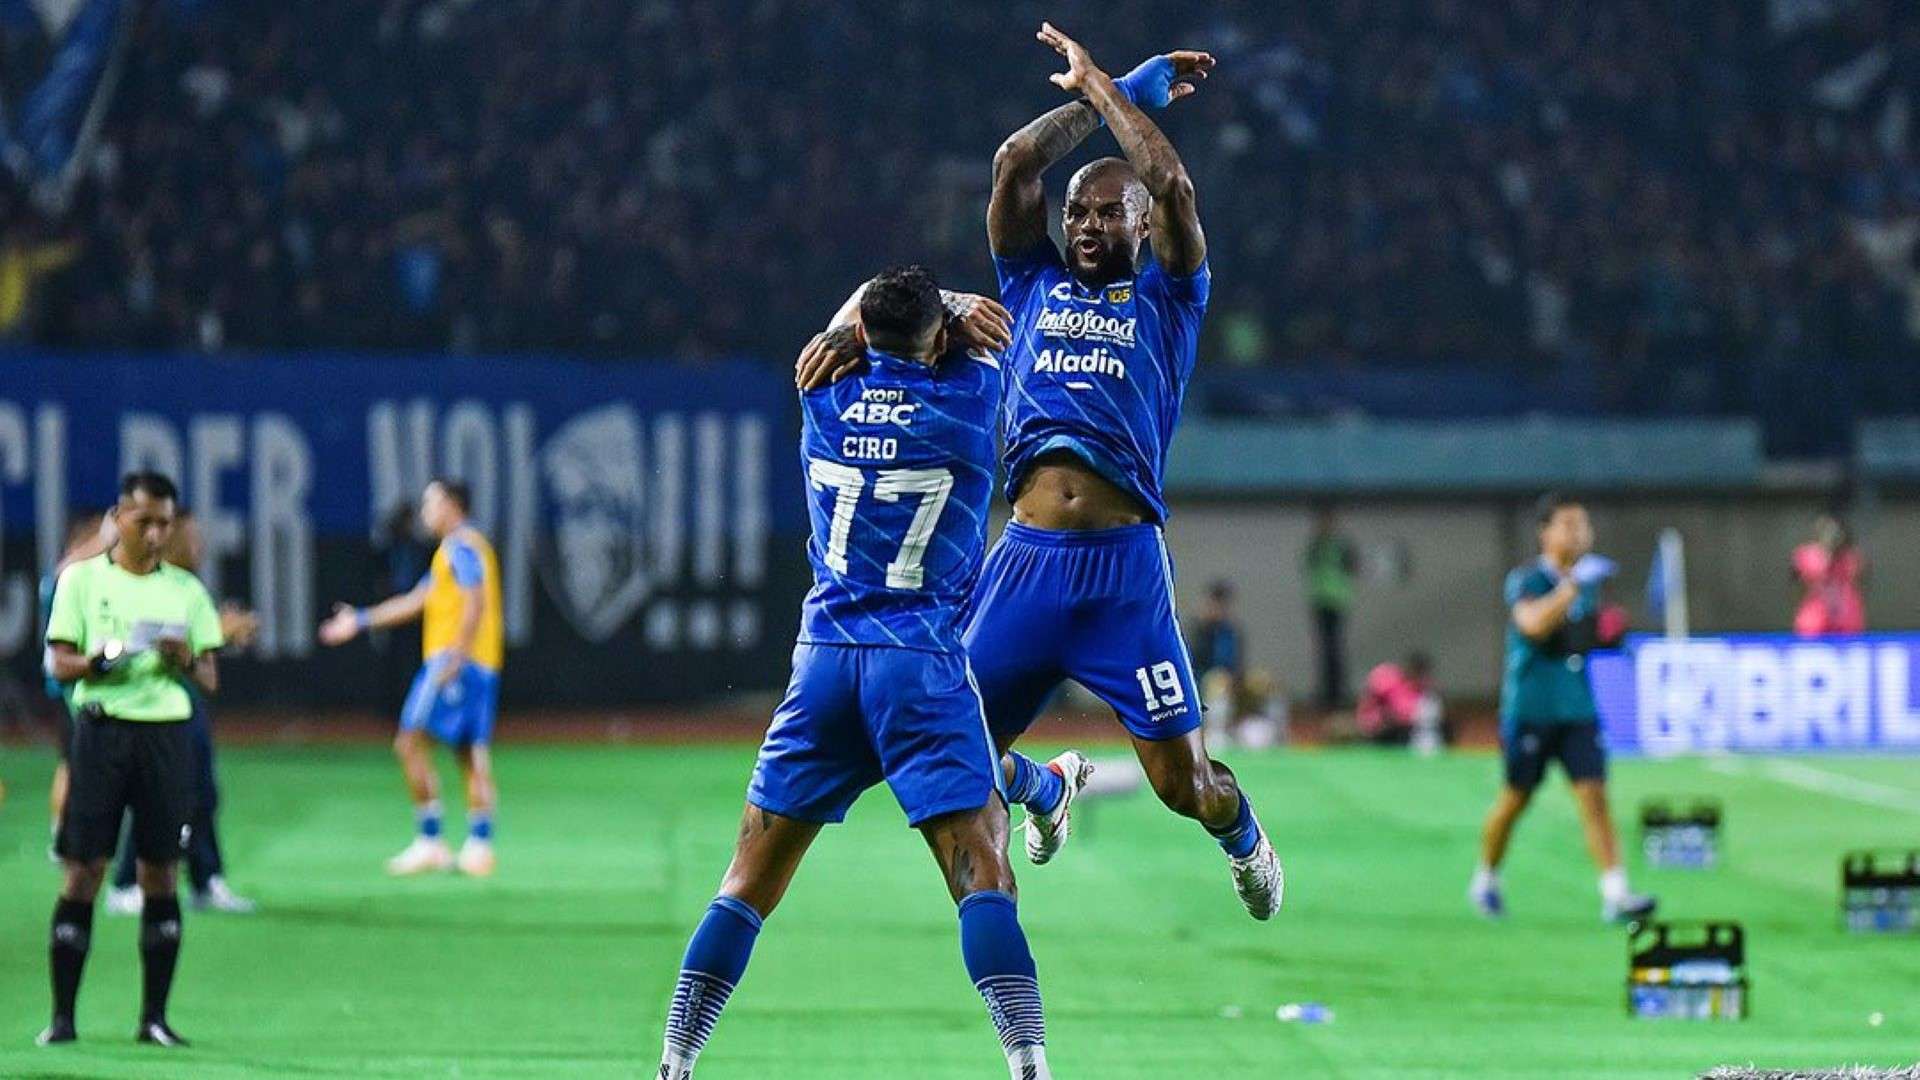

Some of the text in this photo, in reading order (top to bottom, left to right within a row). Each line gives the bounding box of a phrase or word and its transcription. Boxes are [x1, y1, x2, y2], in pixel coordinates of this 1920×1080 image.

[1035, 306, 1137, 340] Indofood
[1034, 348, 1125, 379] Aladin
[861, 387, 905, 403] KOPI
[840, 402, 916, 426] ABC
[842, 436, 898, 460] CIRO
[808, 457, 954, 589] 77
[1136, 660, 1185, 711] 19
